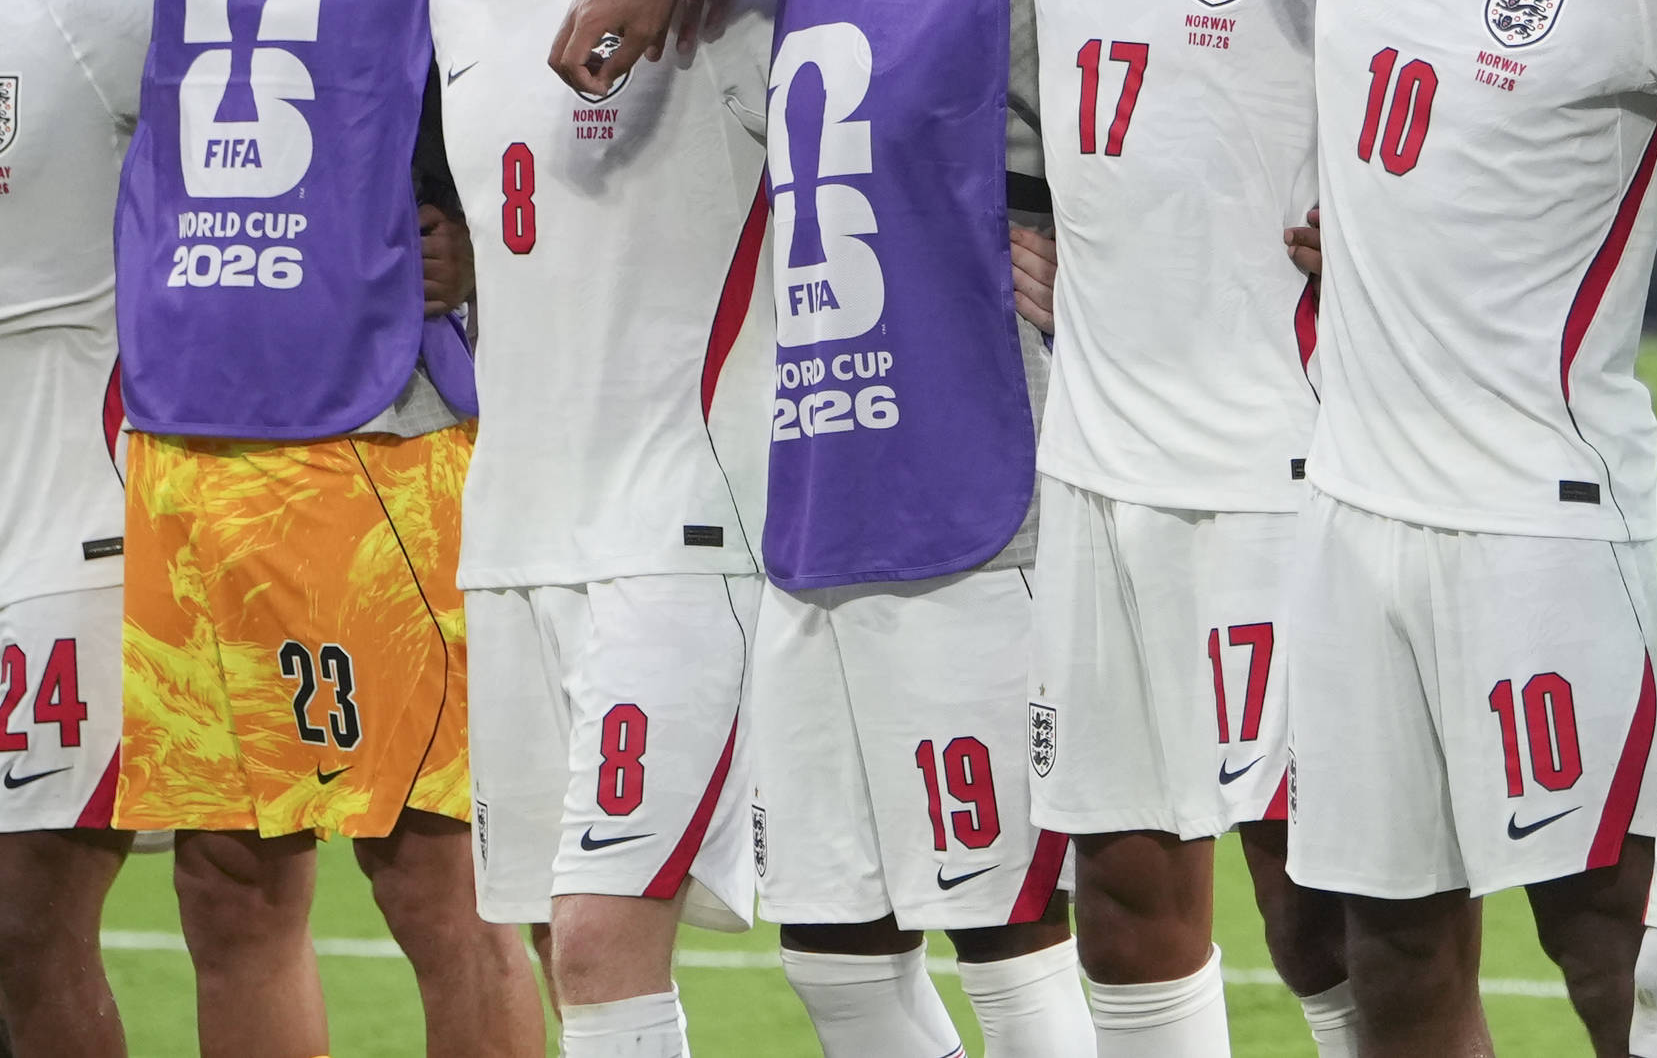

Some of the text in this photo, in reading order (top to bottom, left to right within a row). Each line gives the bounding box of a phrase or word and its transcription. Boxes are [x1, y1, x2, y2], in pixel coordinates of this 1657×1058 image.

[1184, 14, 1237, 33] NORWAY
[1187, 32, 1230, 50] 11.07.26
[1474, 68, 1516, 92] 11.07.26
[1476, 50, 1528, 77] NORWAY
[572, 109, 619, 123] NORWAY
[1076, 38, 1150, 157] 17
[1357, 46, 1439, 177] 10
[204, 138, 263, 169] FIFA
[576, 126, 614, 140] 11.07.26
[502, 142, 537, 256] 8
[245, 211, 308, 239] CUP
[167, 244, 304, 290] 2026
[831, 351, 894, 381] CUP
[772, 385, 900, 442] 2026
[0, 638, 88, 753] 24
[277, 638, 363, 752] 23
[1207, 621, 1275, 745] 17
[596, 703, 649, 817] 8
[1488, 671, 1584, 799] 10
[914, 735, 1002, 852] 19
